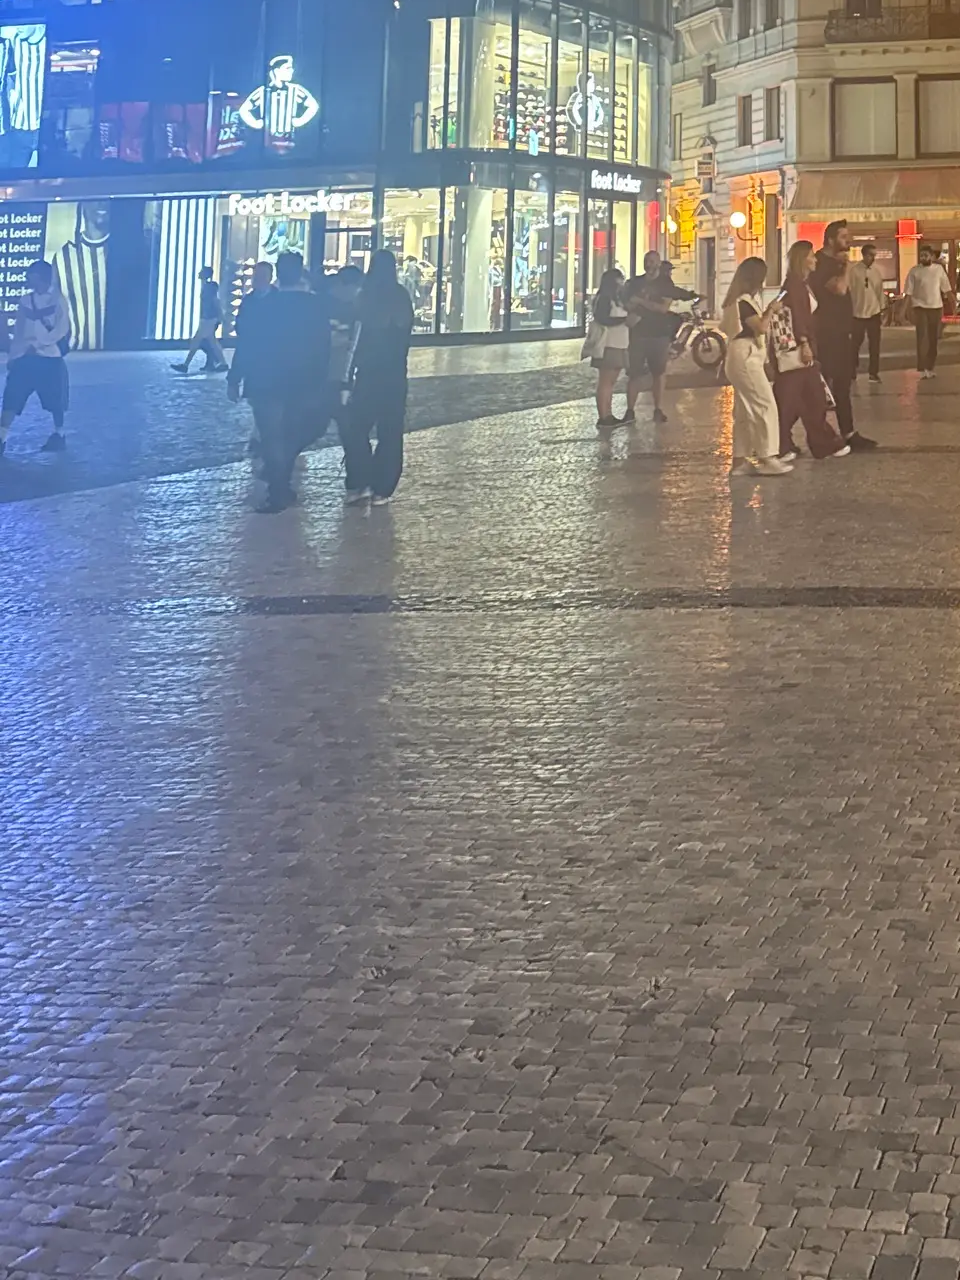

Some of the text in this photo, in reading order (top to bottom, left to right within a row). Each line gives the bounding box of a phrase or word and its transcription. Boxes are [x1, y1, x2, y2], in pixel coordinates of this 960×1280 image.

[591, 169, 641, 193] Foot Locker
[229, 190, 355, 216] Foot Locker
[0, 213, 42, 224] ot Locker
[10, 228, 42, 239] Locker
[9, 242, 41, 253] Locker
